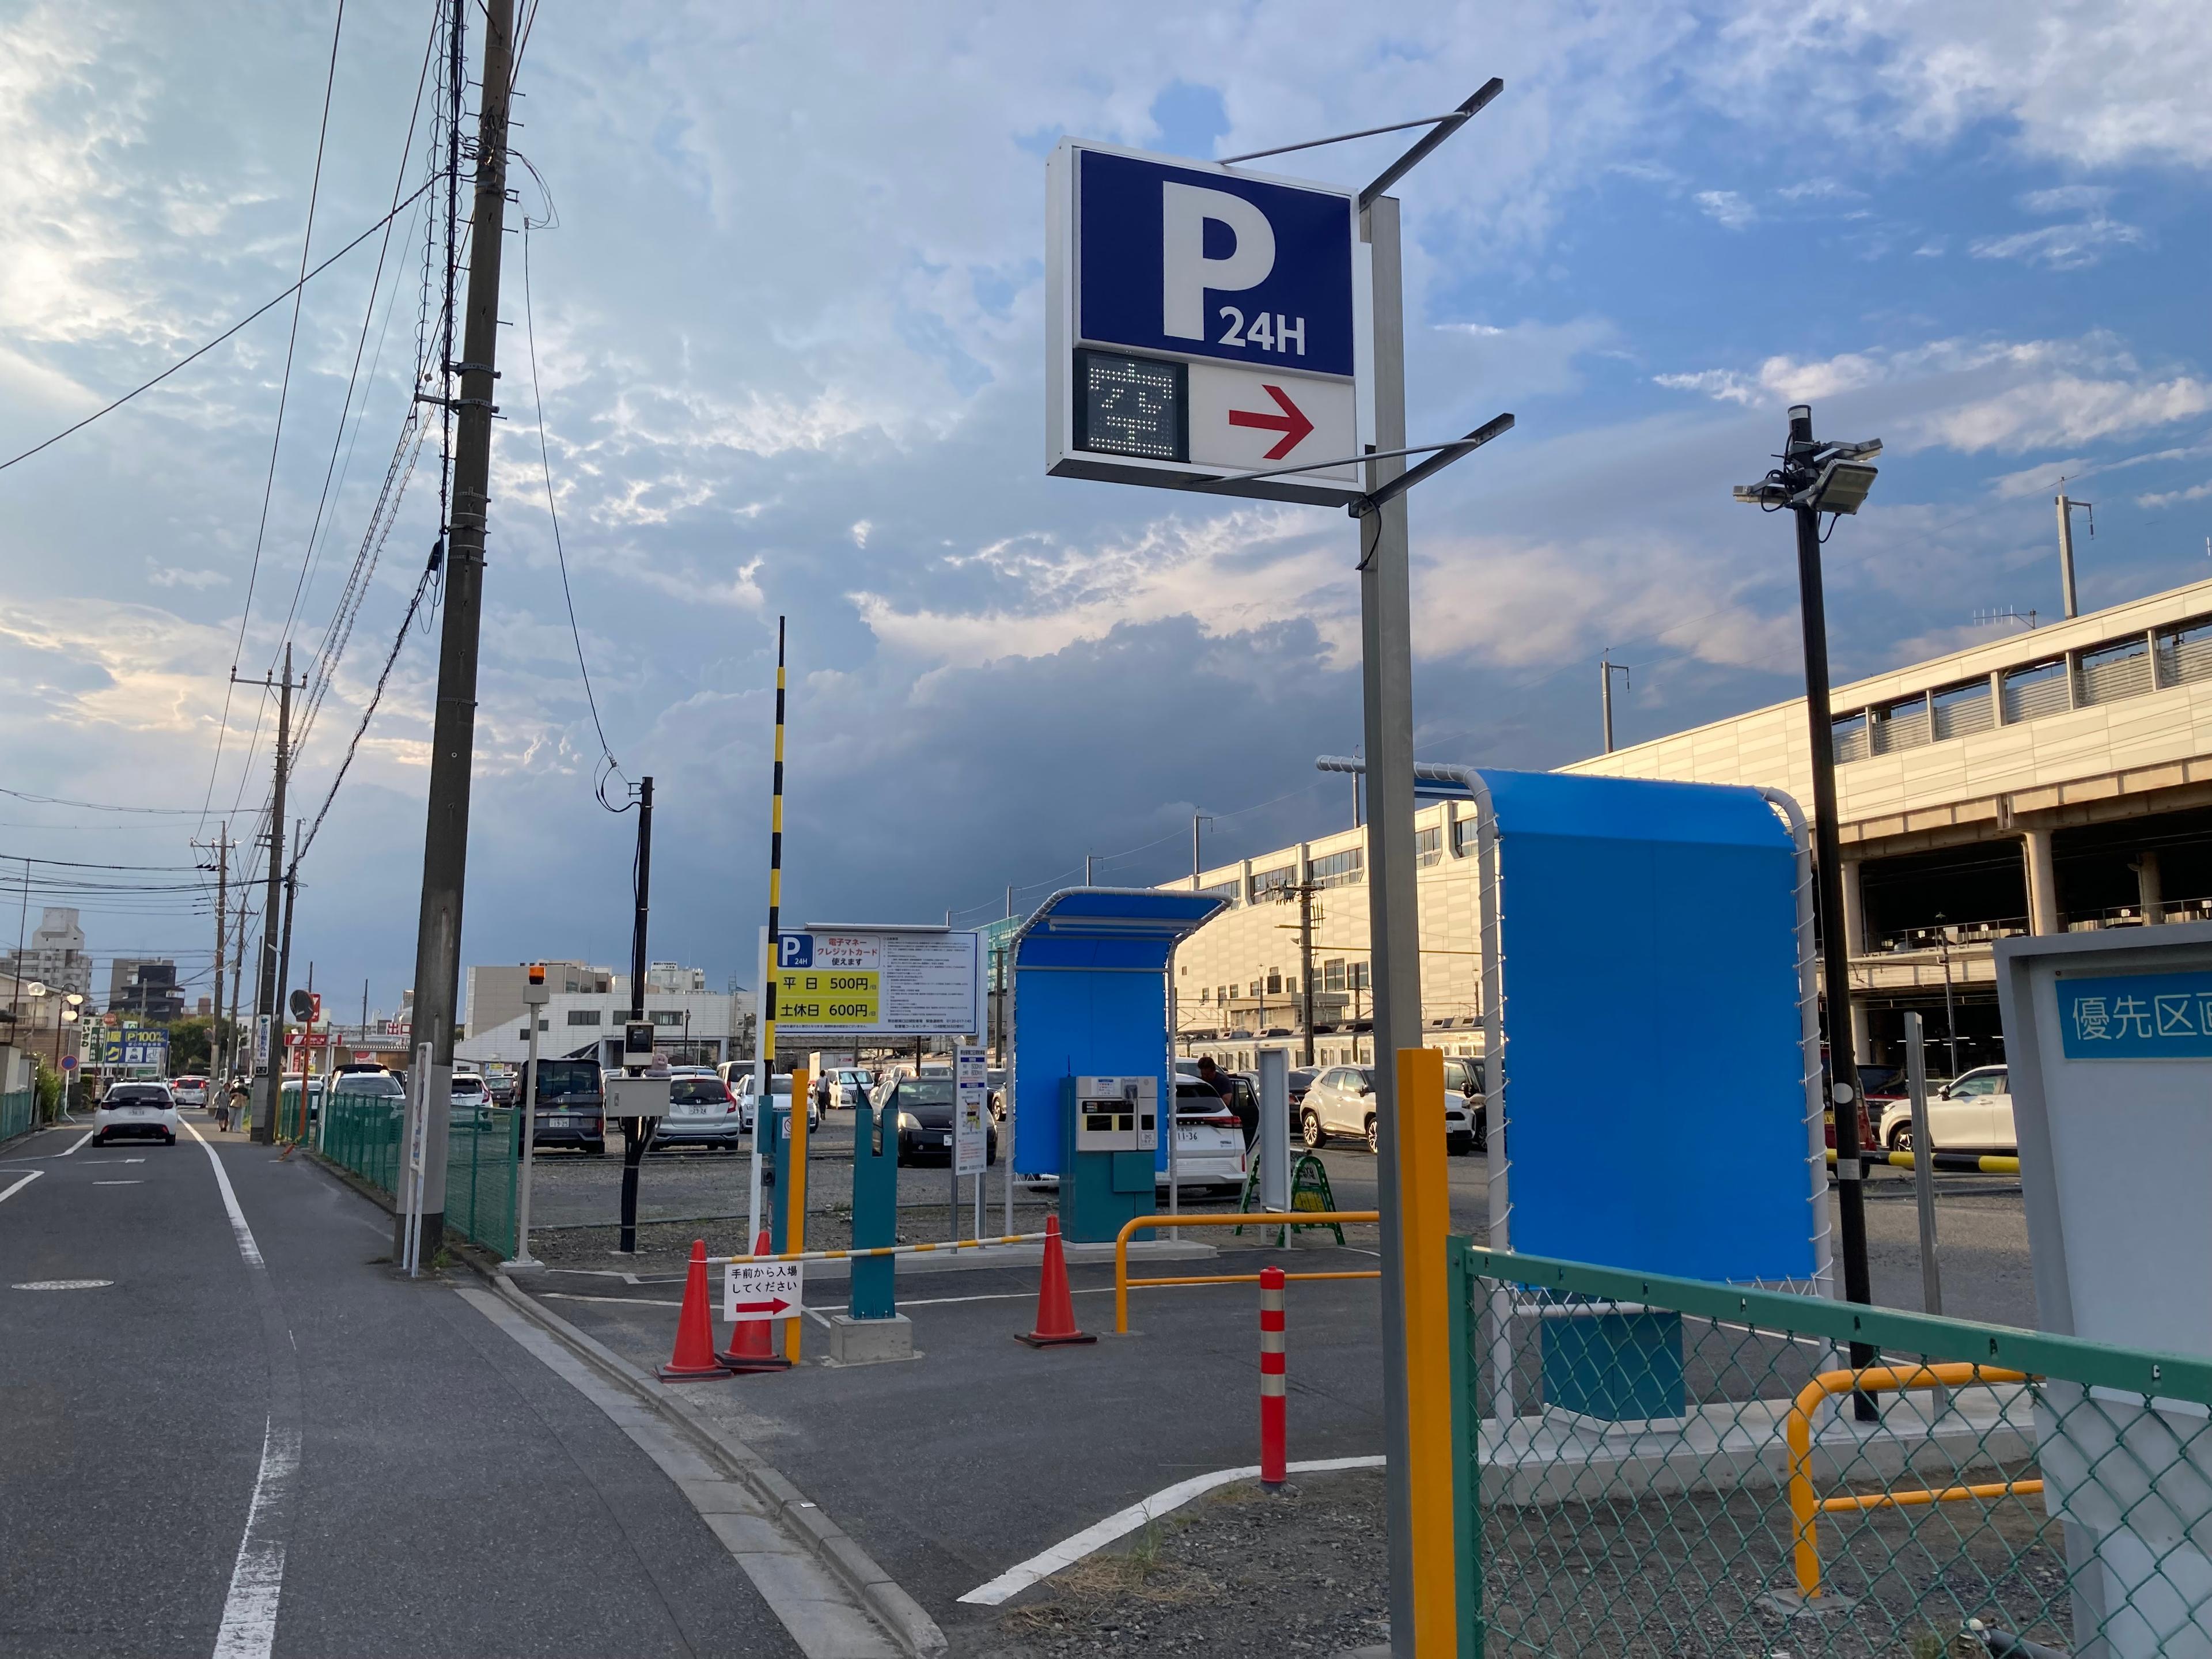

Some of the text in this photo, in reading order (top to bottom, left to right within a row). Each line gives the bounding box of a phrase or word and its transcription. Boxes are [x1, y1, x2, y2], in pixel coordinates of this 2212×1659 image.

[1163, 181, 1275, 341] P
[1218, 306, 1305, 356] 24H
[1089, 362, 1173, 457] 空
[829, 938, 867, 946] 電子マネー
[782, 937, 801, 966] P
[817, 948, 877, 956] クレジットカード
[832, 958, 862, 966] 使えます
[781, 1004, 819, 1017] 土休日
[1178, 1132, 1198, 1140] 11-36
[732, 1266, 797, 1279] 手前から入場
[733, 1281, 797, 1294] してください
